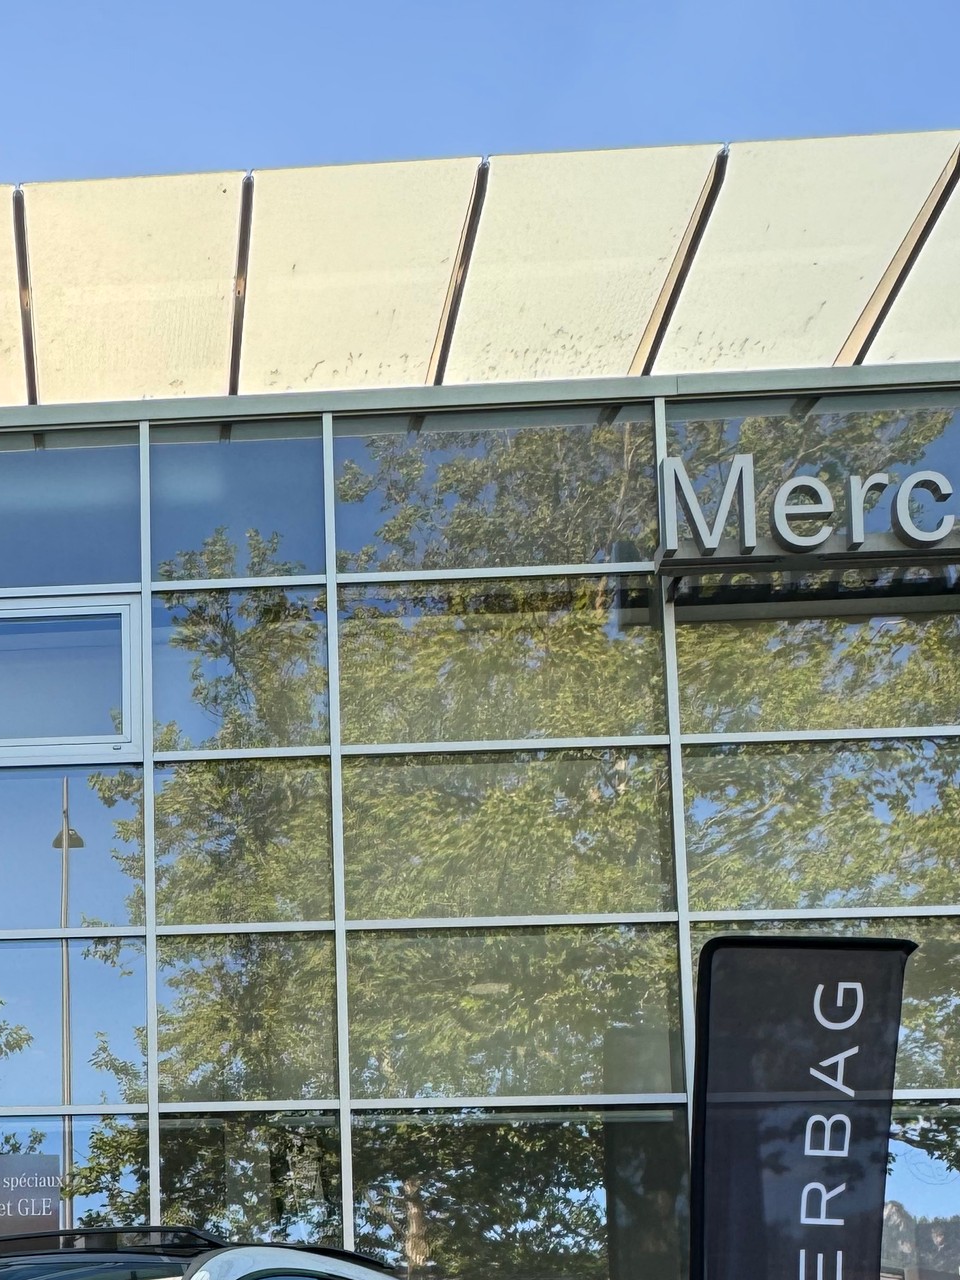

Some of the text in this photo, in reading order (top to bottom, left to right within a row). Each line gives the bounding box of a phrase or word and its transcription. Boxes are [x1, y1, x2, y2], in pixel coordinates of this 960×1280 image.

[660, 453, 955, 554] Merc
[3, 1172, 64, 1191] spéciaux
[17, 1198, 53, 1216] GLE
